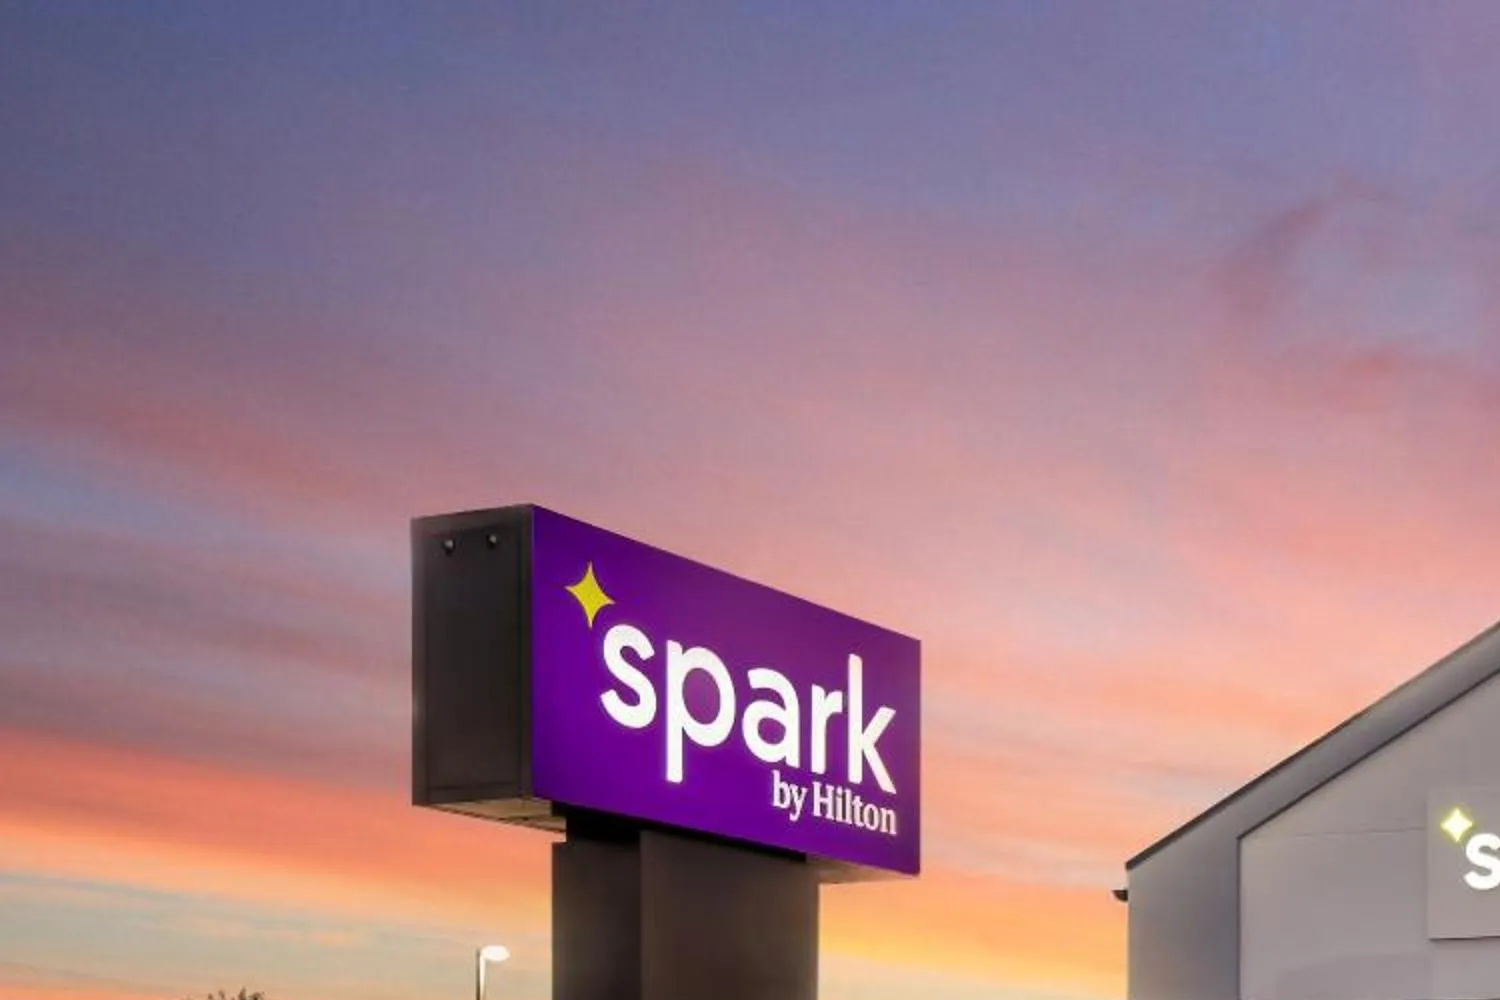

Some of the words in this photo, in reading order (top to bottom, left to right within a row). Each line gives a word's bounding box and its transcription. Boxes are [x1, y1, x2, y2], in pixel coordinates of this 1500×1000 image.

[600, 623, 897, 795] spark
[772, 770, 807, 820] by
[812, 781, 897, 836] Hilton
